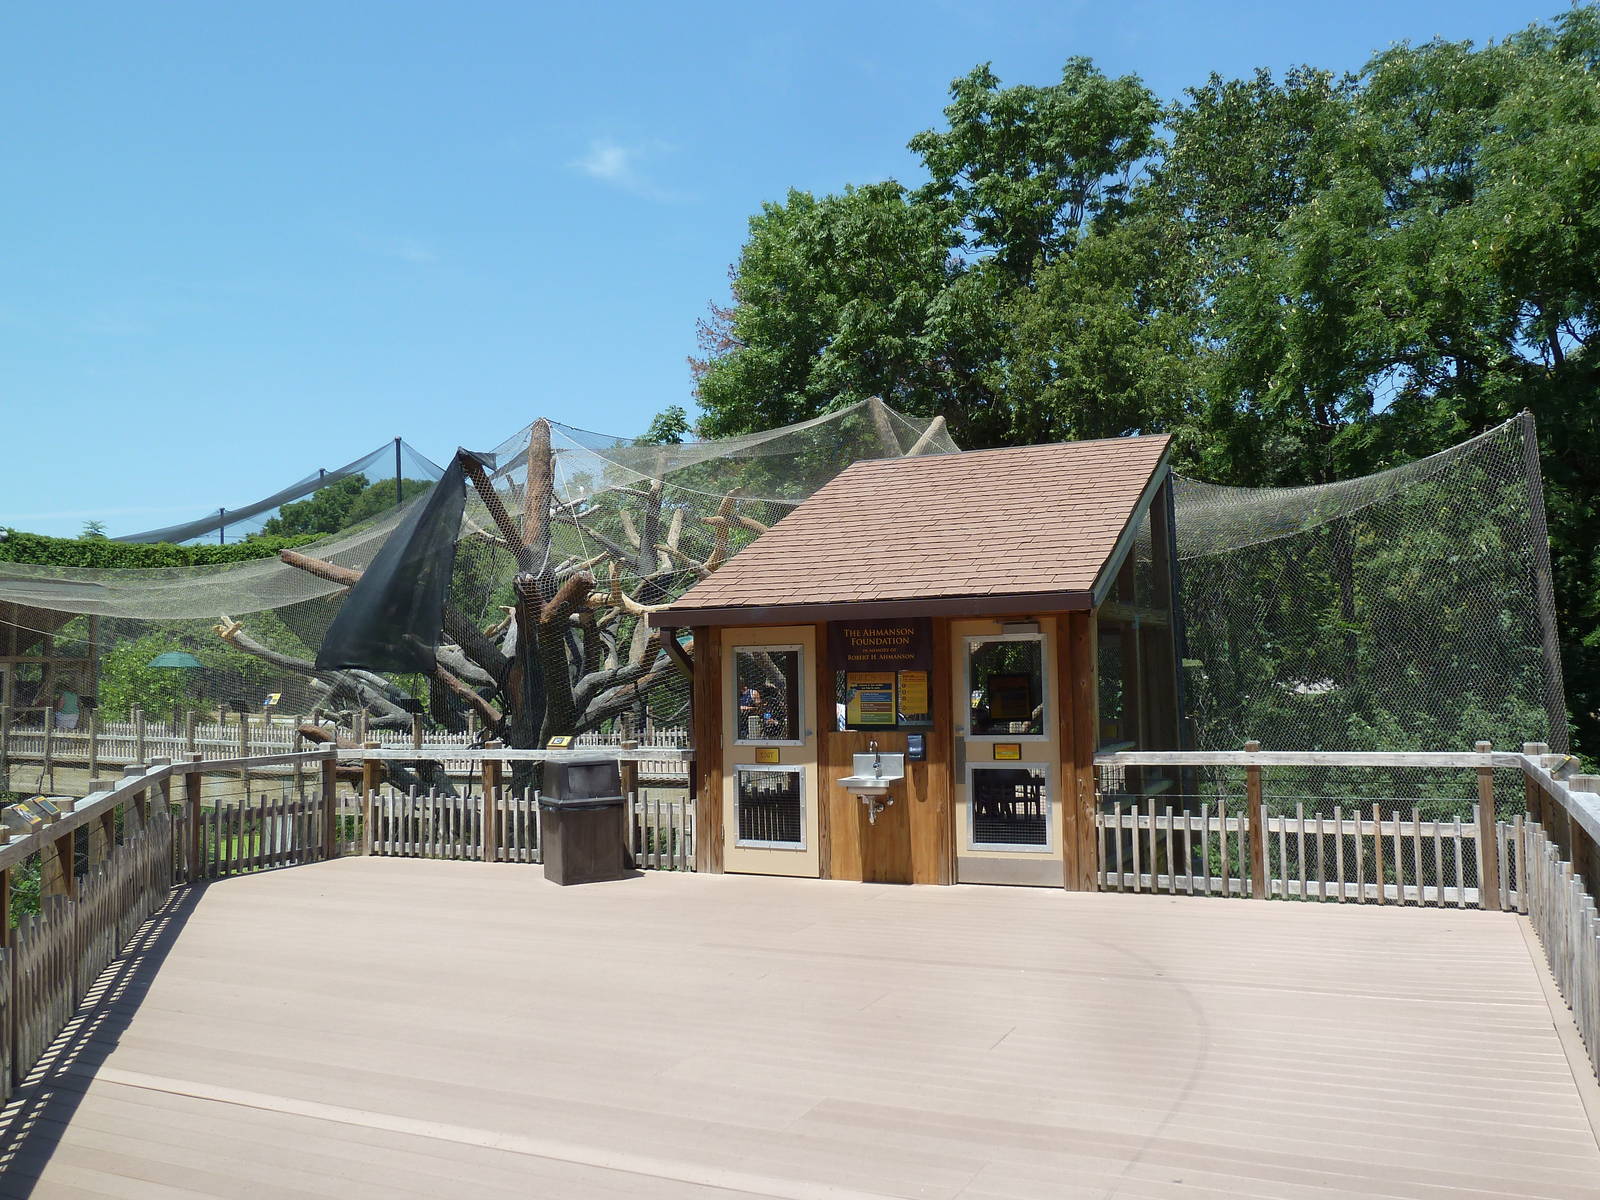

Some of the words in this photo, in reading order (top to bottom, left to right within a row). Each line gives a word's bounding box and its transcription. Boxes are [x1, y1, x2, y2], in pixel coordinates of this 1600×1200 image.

[844, 629, 861, 638] THE
[864, 628, 914, 637] AHMANSON
[851, 637, 910, 646] FOUNDATION
